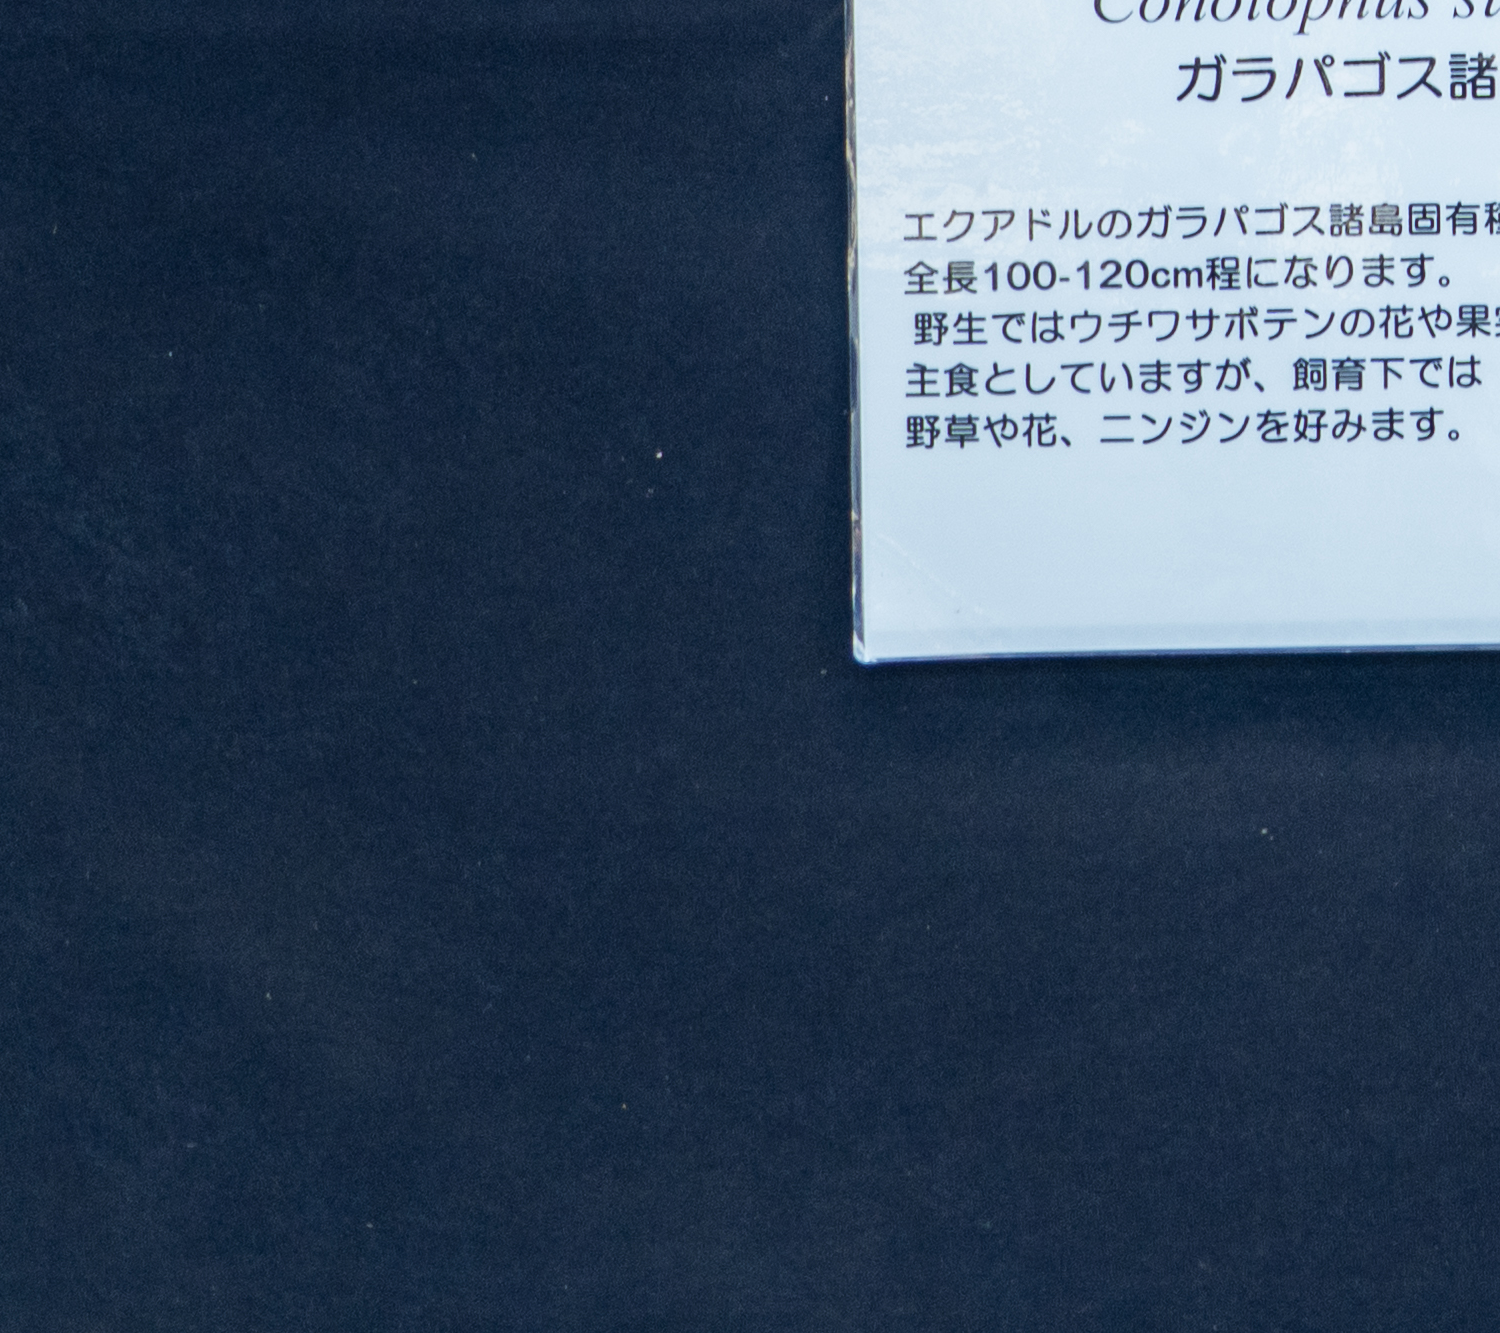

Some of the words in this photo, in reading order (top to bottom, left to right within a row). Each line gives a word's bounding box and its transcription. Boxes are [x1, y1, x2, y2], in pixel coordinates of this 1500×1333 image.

[903, 254, 1452, 294] 全長100-120cm程になります。
[905, 355, 1483, 397] 主食としていますが、飼育下では
[906, 406, 1461, 449] 野草や花、ニンジンを好みます。
